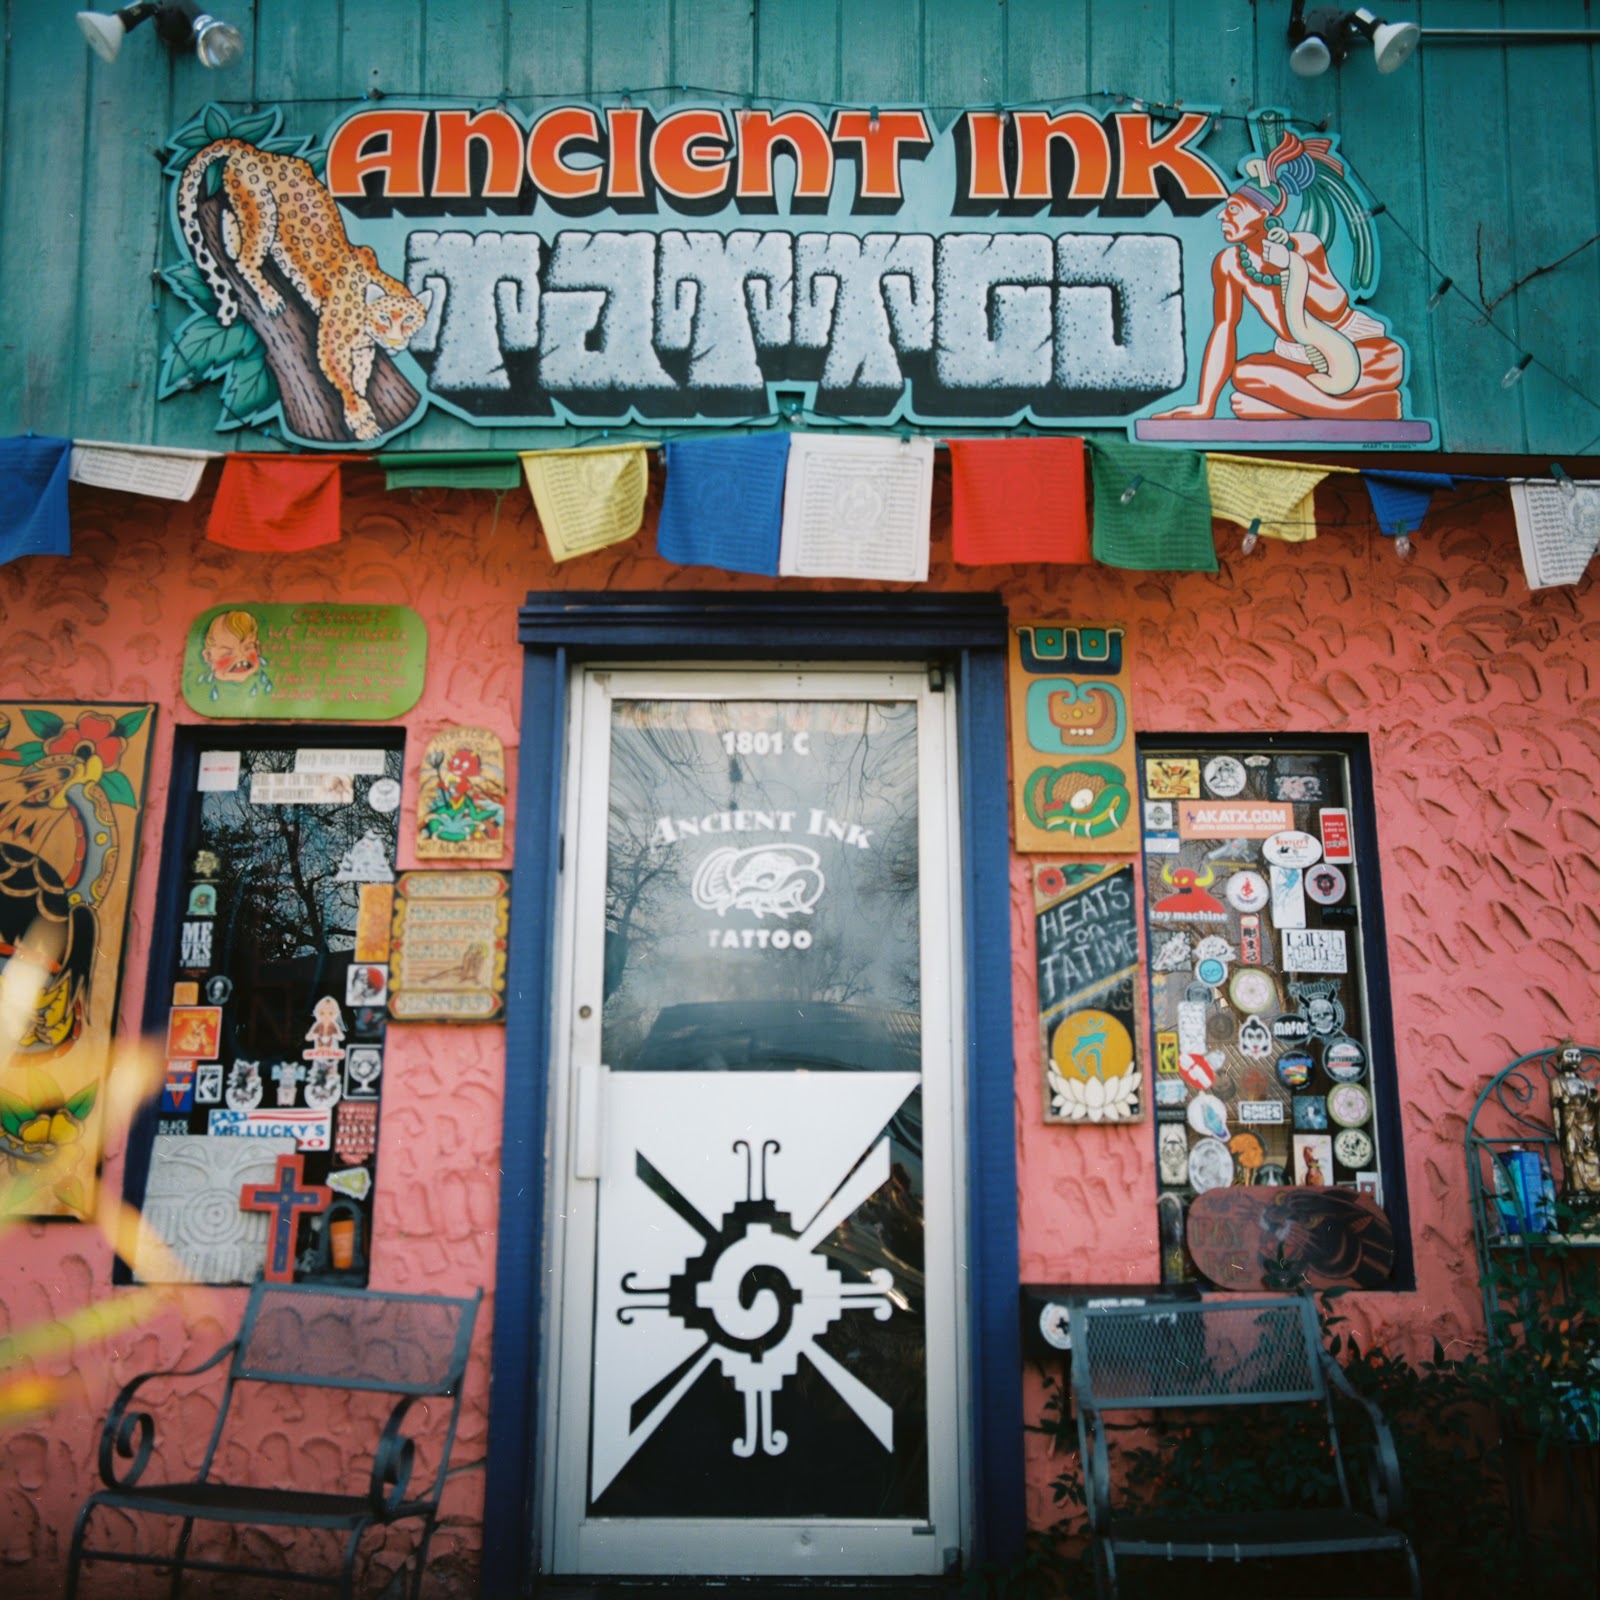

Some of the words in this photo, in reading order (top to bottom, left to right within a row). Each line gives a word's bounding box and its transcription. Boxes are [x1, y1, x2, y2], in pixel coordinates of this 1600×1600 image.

[327, 107, 932, 200] ANCIENT
[966, 109, 1230, 201] INK
[405, 230, 1186, 393] TATTOO
[722, 731, 785, 756] 1801
[792, 732, 810, 756] C
[806, 807, 875, 850] INK
[1195, 809, 1287, 824] AKATX.COM
[1040, 876, 1131, 944] HEATS
[1174, 910, 1229, 922] machine
[708, 928, 813, 950] TATTOO
